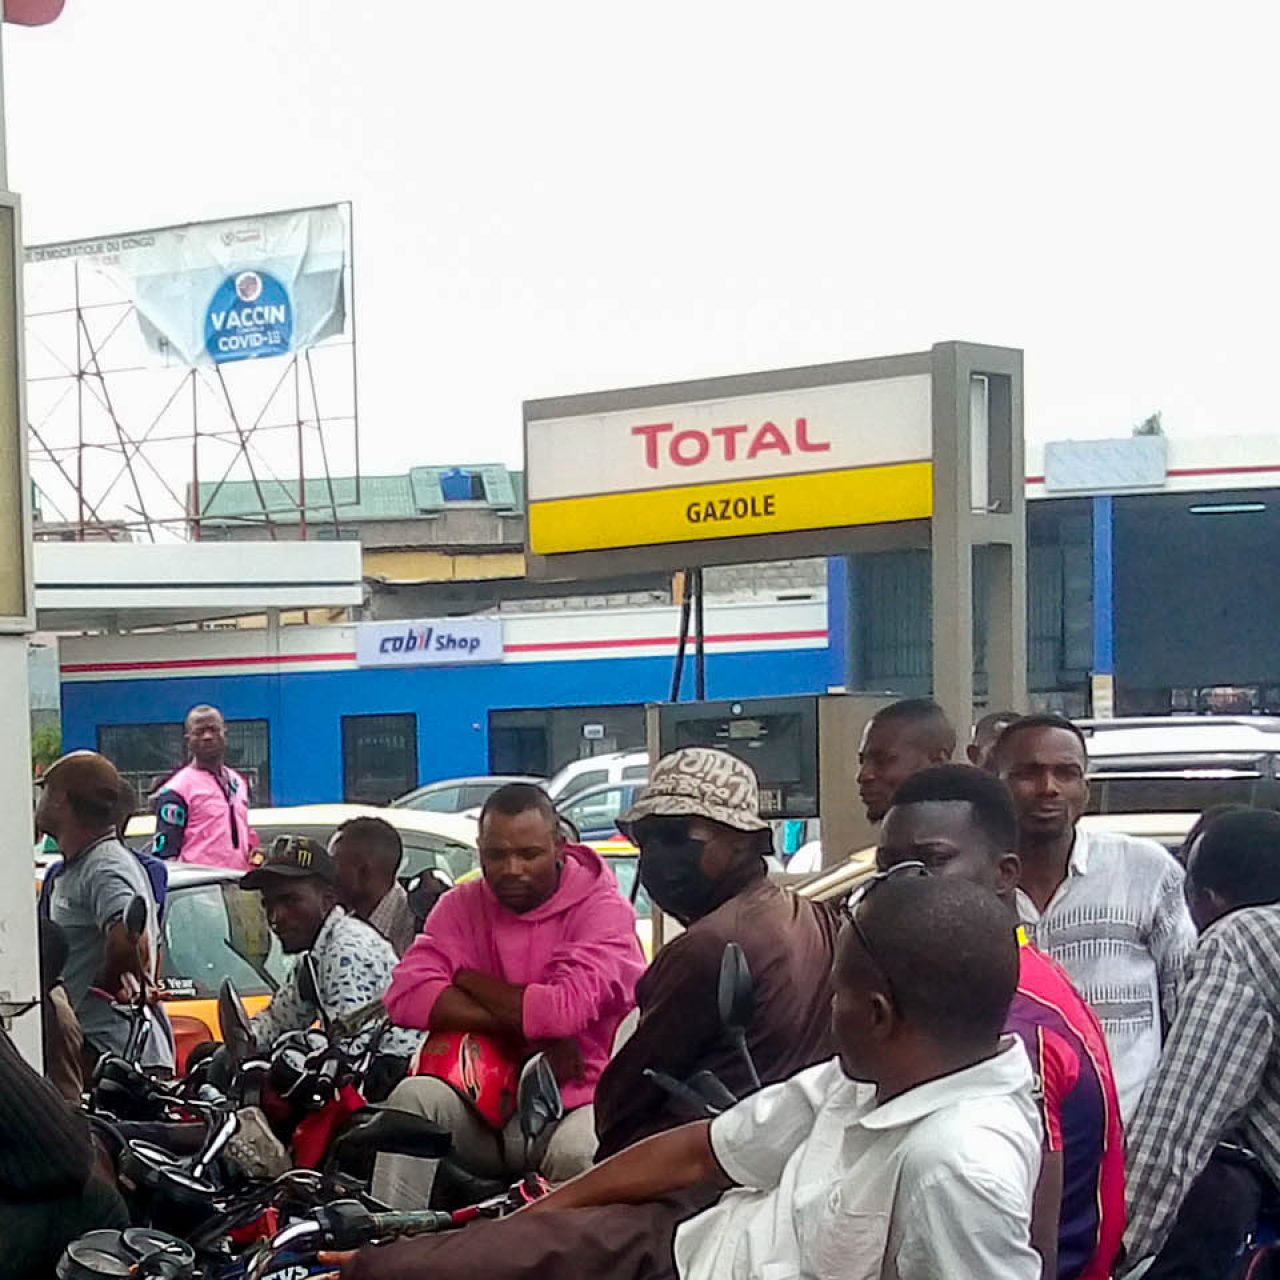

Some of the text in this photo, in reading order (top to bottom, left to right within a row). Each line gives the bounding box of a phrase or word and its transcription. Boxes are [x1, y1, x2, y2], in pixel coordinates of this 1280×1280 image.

[211, 304, 285, 330] VACCIN
[631, 417, 831, 470] TOTAL
[686, 495, 776, 524] GAZOLE
[435, 633, 481, 655] Shop
